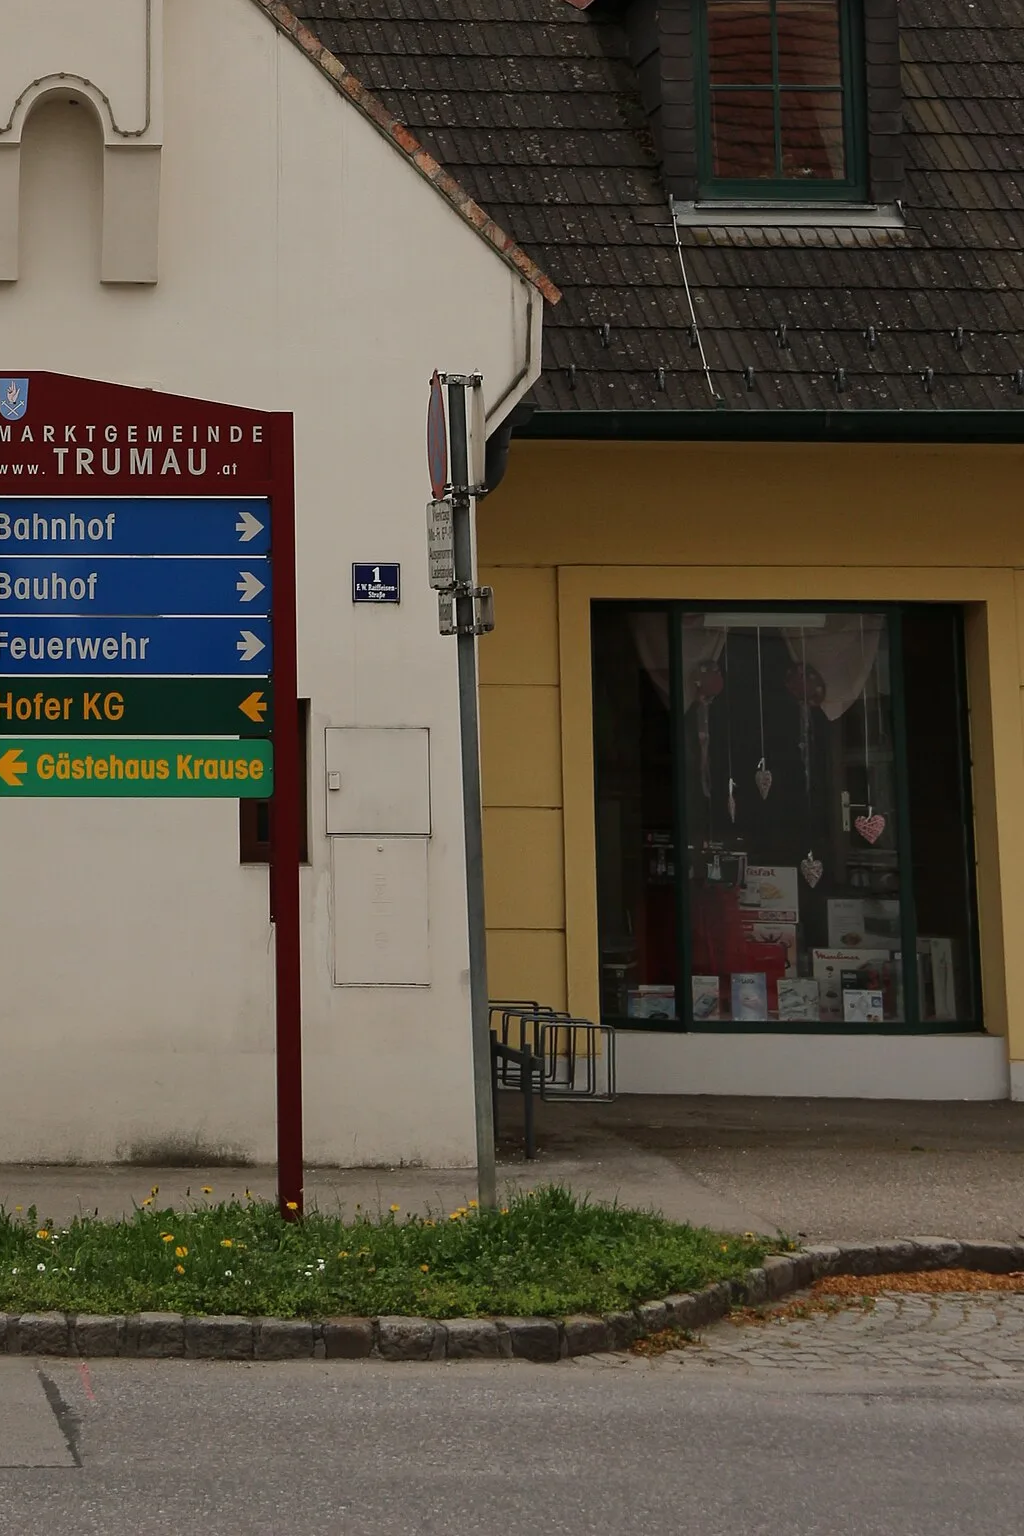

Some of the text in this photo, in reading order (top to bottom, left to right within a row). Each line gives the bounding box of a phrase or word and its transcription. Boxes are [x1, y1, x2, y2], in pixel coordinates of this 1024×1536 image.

[53, 448, 207, 476] TRUMAU
[216, 462, 238, 476] .at
[371, 566, 381, 582] 1
[368, 591, 386, 600] Straße
[83, 692, 125, 720] KG
[36, 752, 264, 780] Gästehaus Krause
